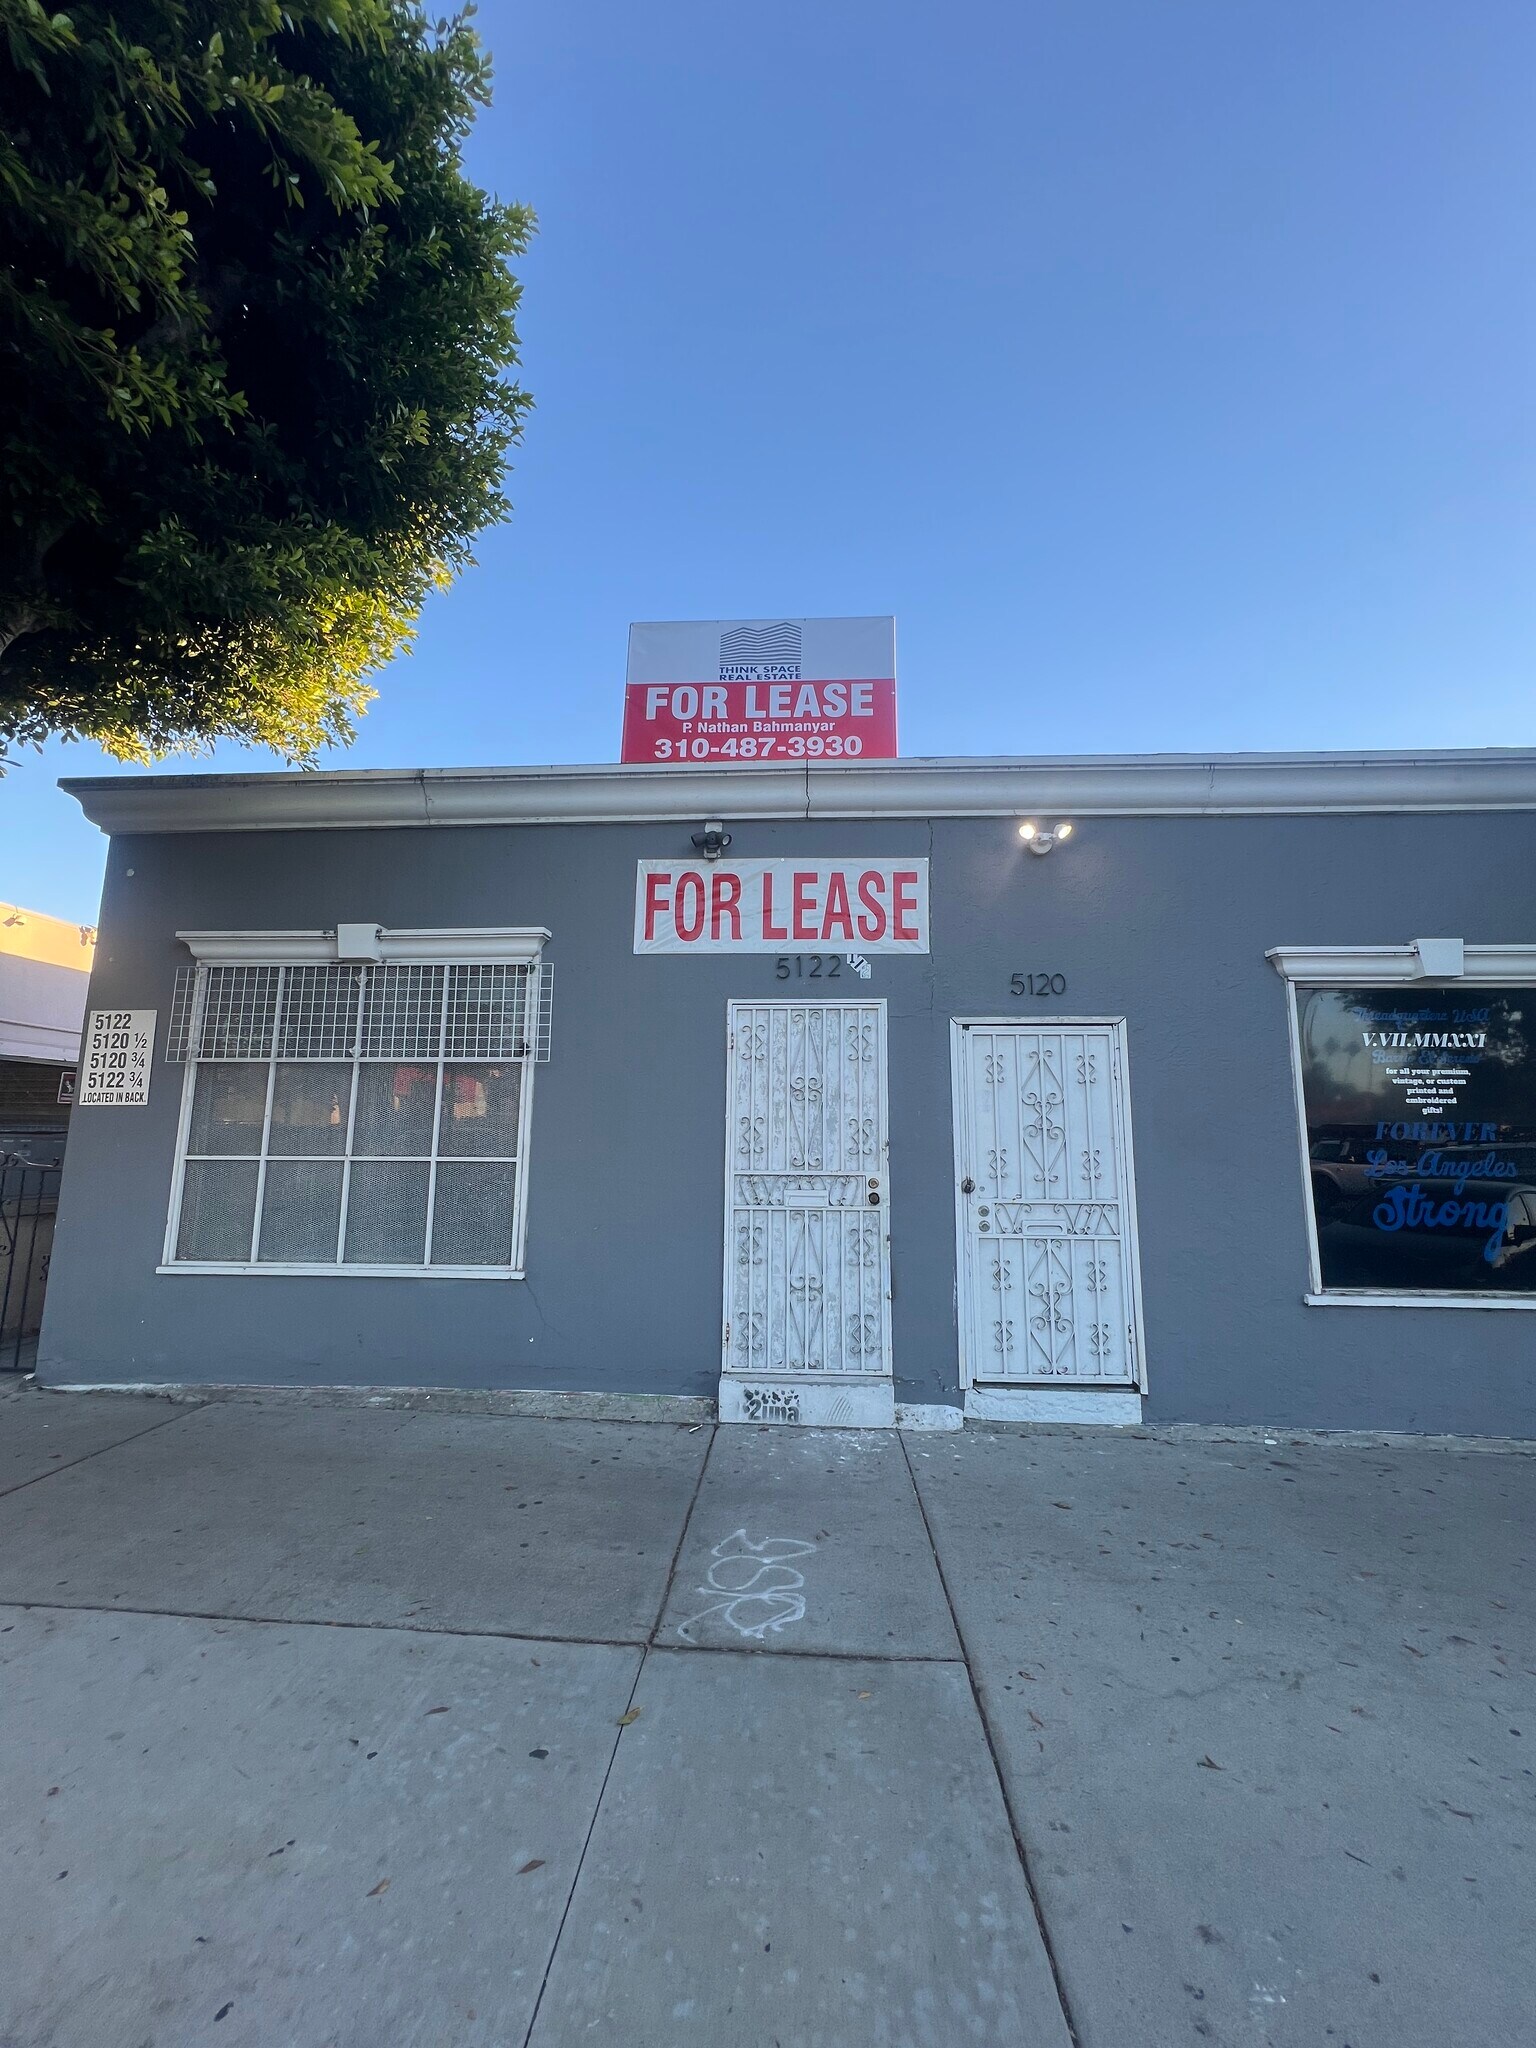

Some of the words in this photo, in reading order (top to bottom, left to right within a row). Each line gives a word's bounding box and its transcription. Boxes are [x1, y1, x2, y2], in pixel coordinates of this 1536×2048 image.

[646, 686, 728, 720] FOR
[745, 683, 874, 718] LEASE
[682, 722, 692, 733] P.
[698, 722, 748, 733] Nathan
[753, 721, 836, 733] Bahmanyar
[654, 735, 863, 758] 310-487-3930
[644, 872, 743, 942] FOR
[762, 871, 919, 941] LEASE
[776, 955, 840, 979] 5122
[1011, 973, 1065, 995] 5120
[95, 1013, 131, 1030] 5122
[92, 1033, 129, 1049] 5120
[1362, 1033, 1487, 1048] V.VII.MMXXI
[90, 1052, 127, 1068] 5120
[88, 1072, 125, 1088] 5122
[83, 1092, 114, 1103] LOCATED
[115, 1092, 123, 1103] IN
[1407, 1087, 1437, 1095] printed
[1422, 1107, 1443, 1115] gifts!
[1375, 1121, 1497, 1141] FOREVER
[1364, 1148, 1408, 1177] Los
[1417, 1150, 1518, 1195] Angeles
[1373, 1183, 1509, 1263] Strong
